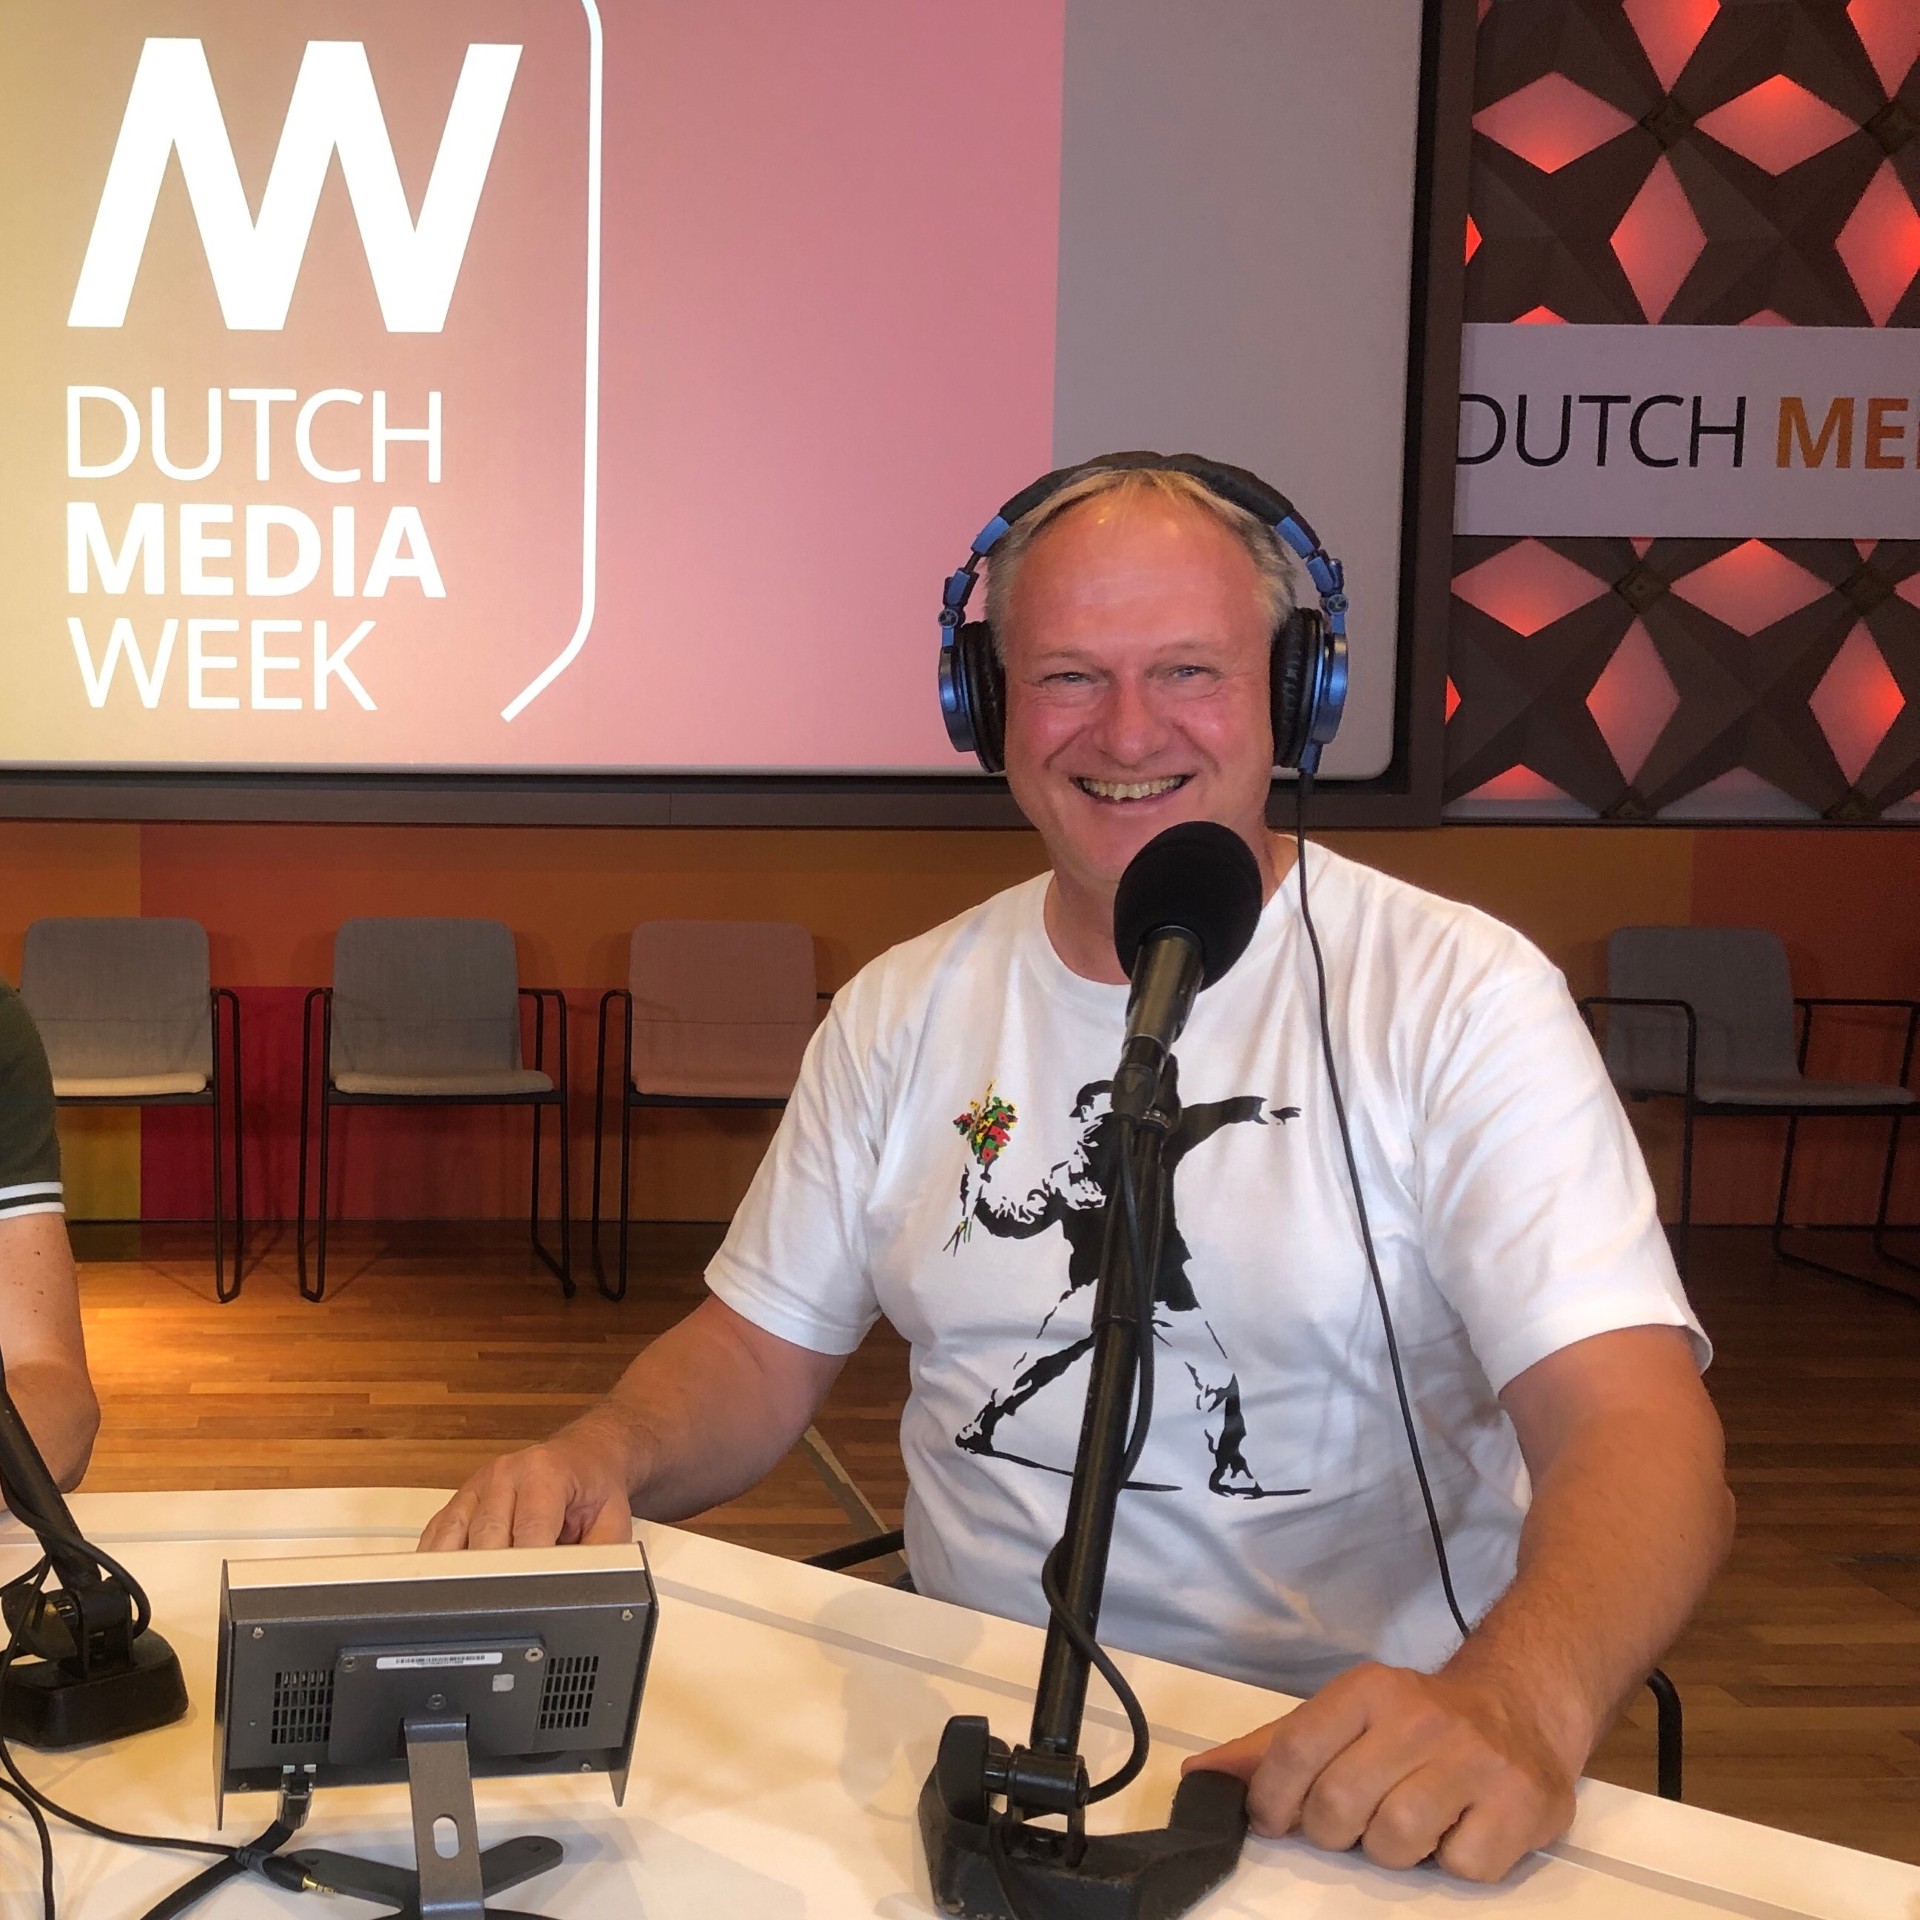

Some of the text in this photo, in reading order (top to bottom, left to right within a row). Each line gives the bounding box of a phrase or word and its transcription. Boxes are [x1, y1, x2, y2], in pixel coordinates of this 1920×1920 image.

[67, 385, 442, 484] DUTCH
[1456, 393, 1920, 470] DUTCH ME
[67, 502, 447, 598] MEDIA
[67, 617, 378, 711] WEEK
